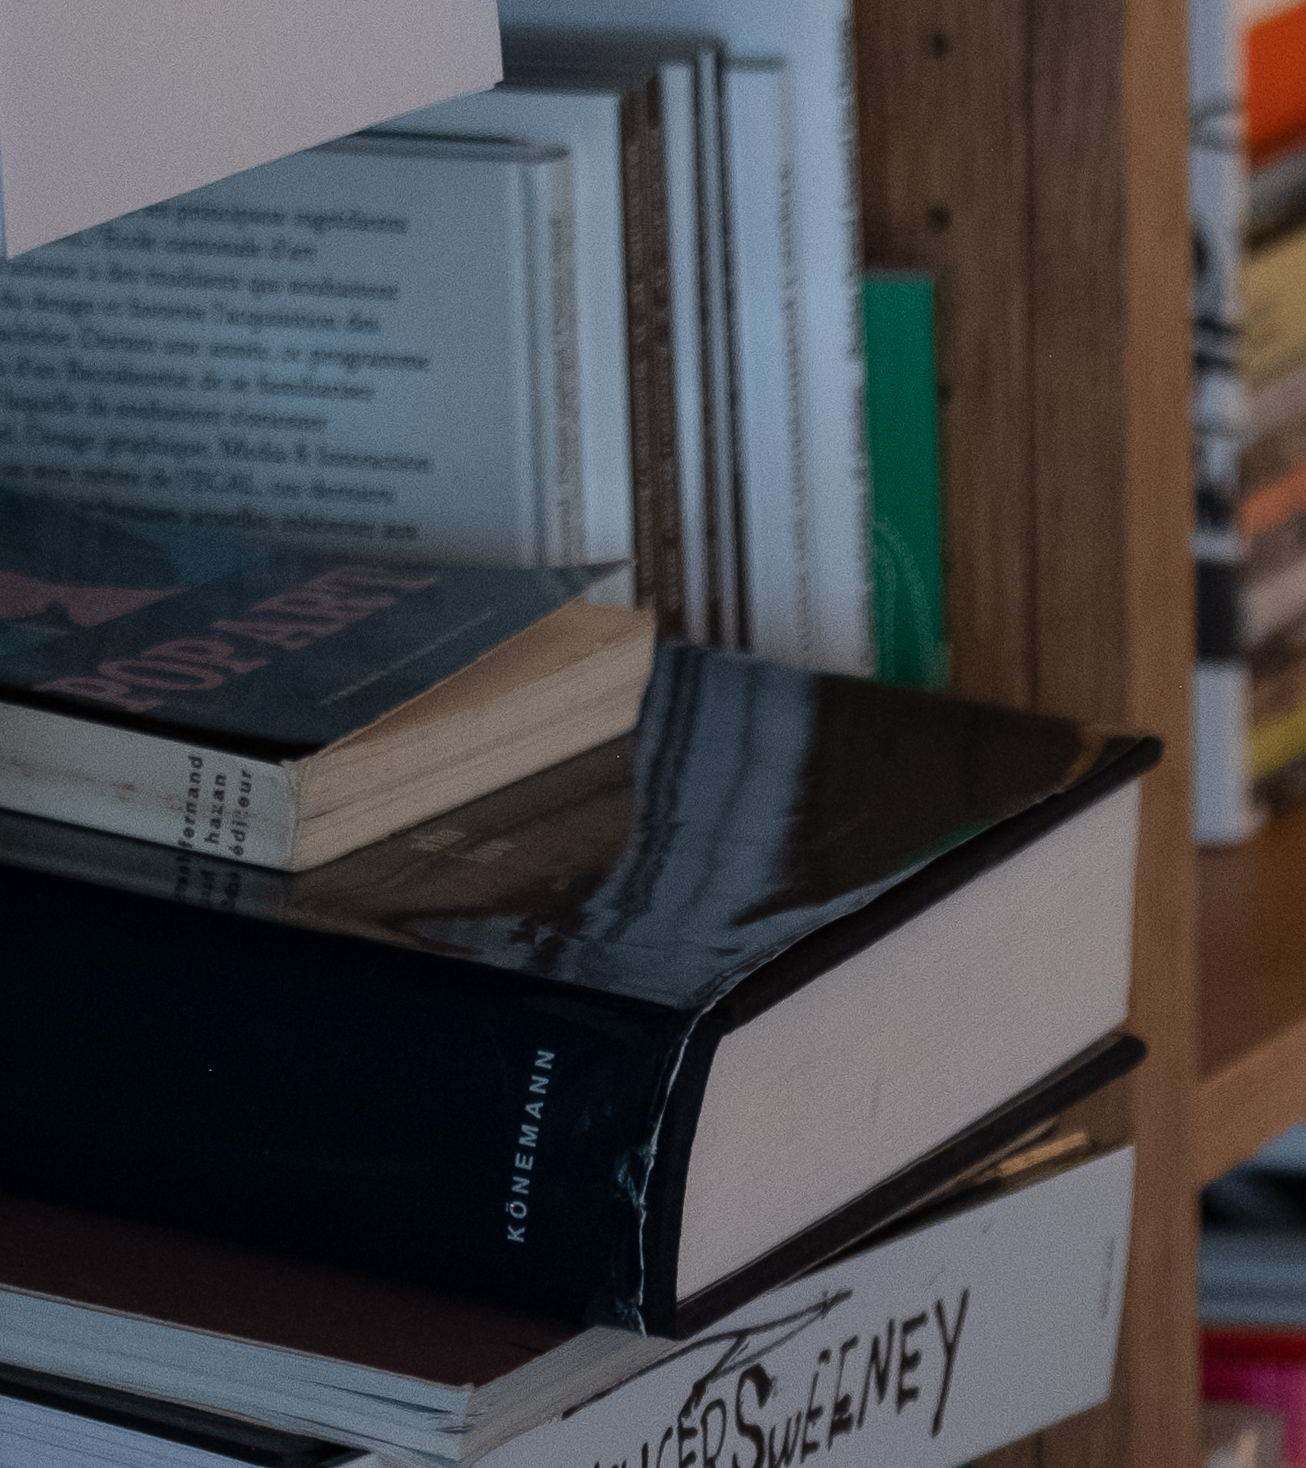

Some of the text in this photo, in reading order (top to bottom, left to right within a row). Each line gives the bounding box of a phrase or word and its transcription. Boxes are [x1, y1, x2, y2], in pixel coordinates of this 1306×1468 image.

[33, 638, 271, 712] POP
[213, 563, 439, 651] ART
[178, 752, 204, 849] fernand
[203, 772, 228, 846] hazan
[505, 1048, 557, 1244] KÖNEMANN
